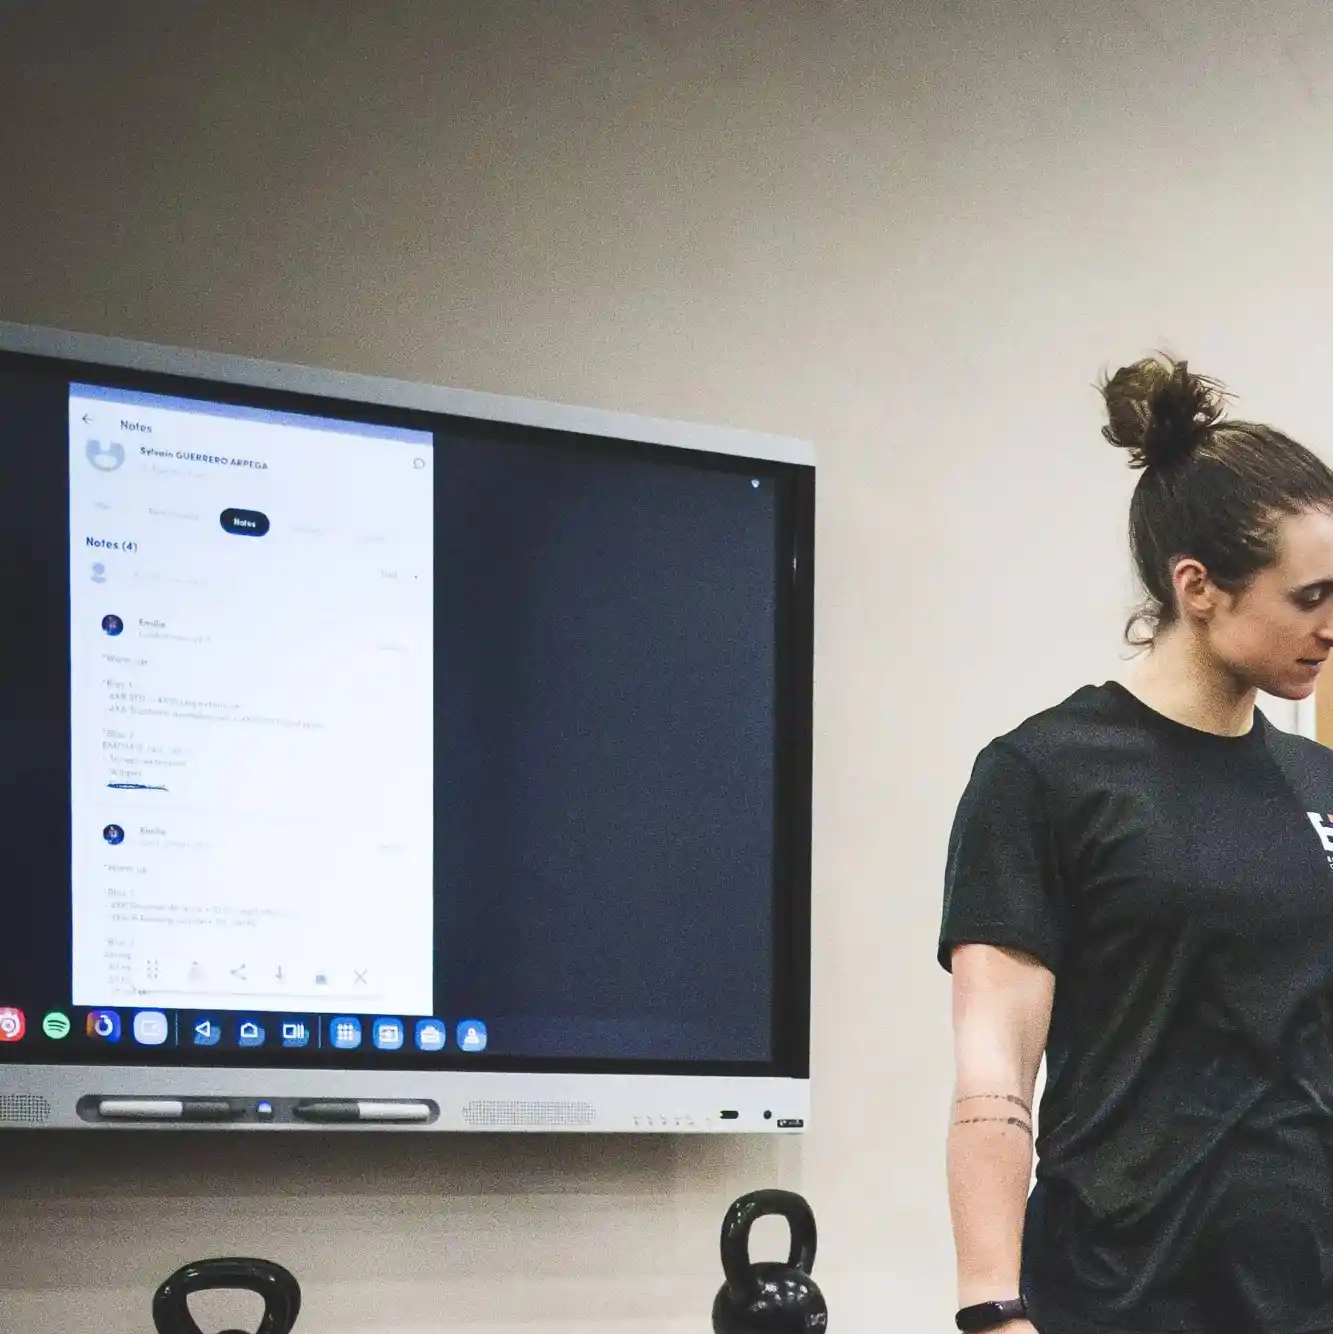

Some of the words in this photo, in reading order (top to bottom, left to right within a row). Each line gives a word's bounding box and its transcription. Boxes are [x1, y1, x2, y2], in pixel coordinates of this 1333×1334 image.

[120, 419, 153, 434] Notes
[233, 517, 257, 529] Notes
[86, 536, 119, 550] Notes
[122, 541, 138, 554] (4)
